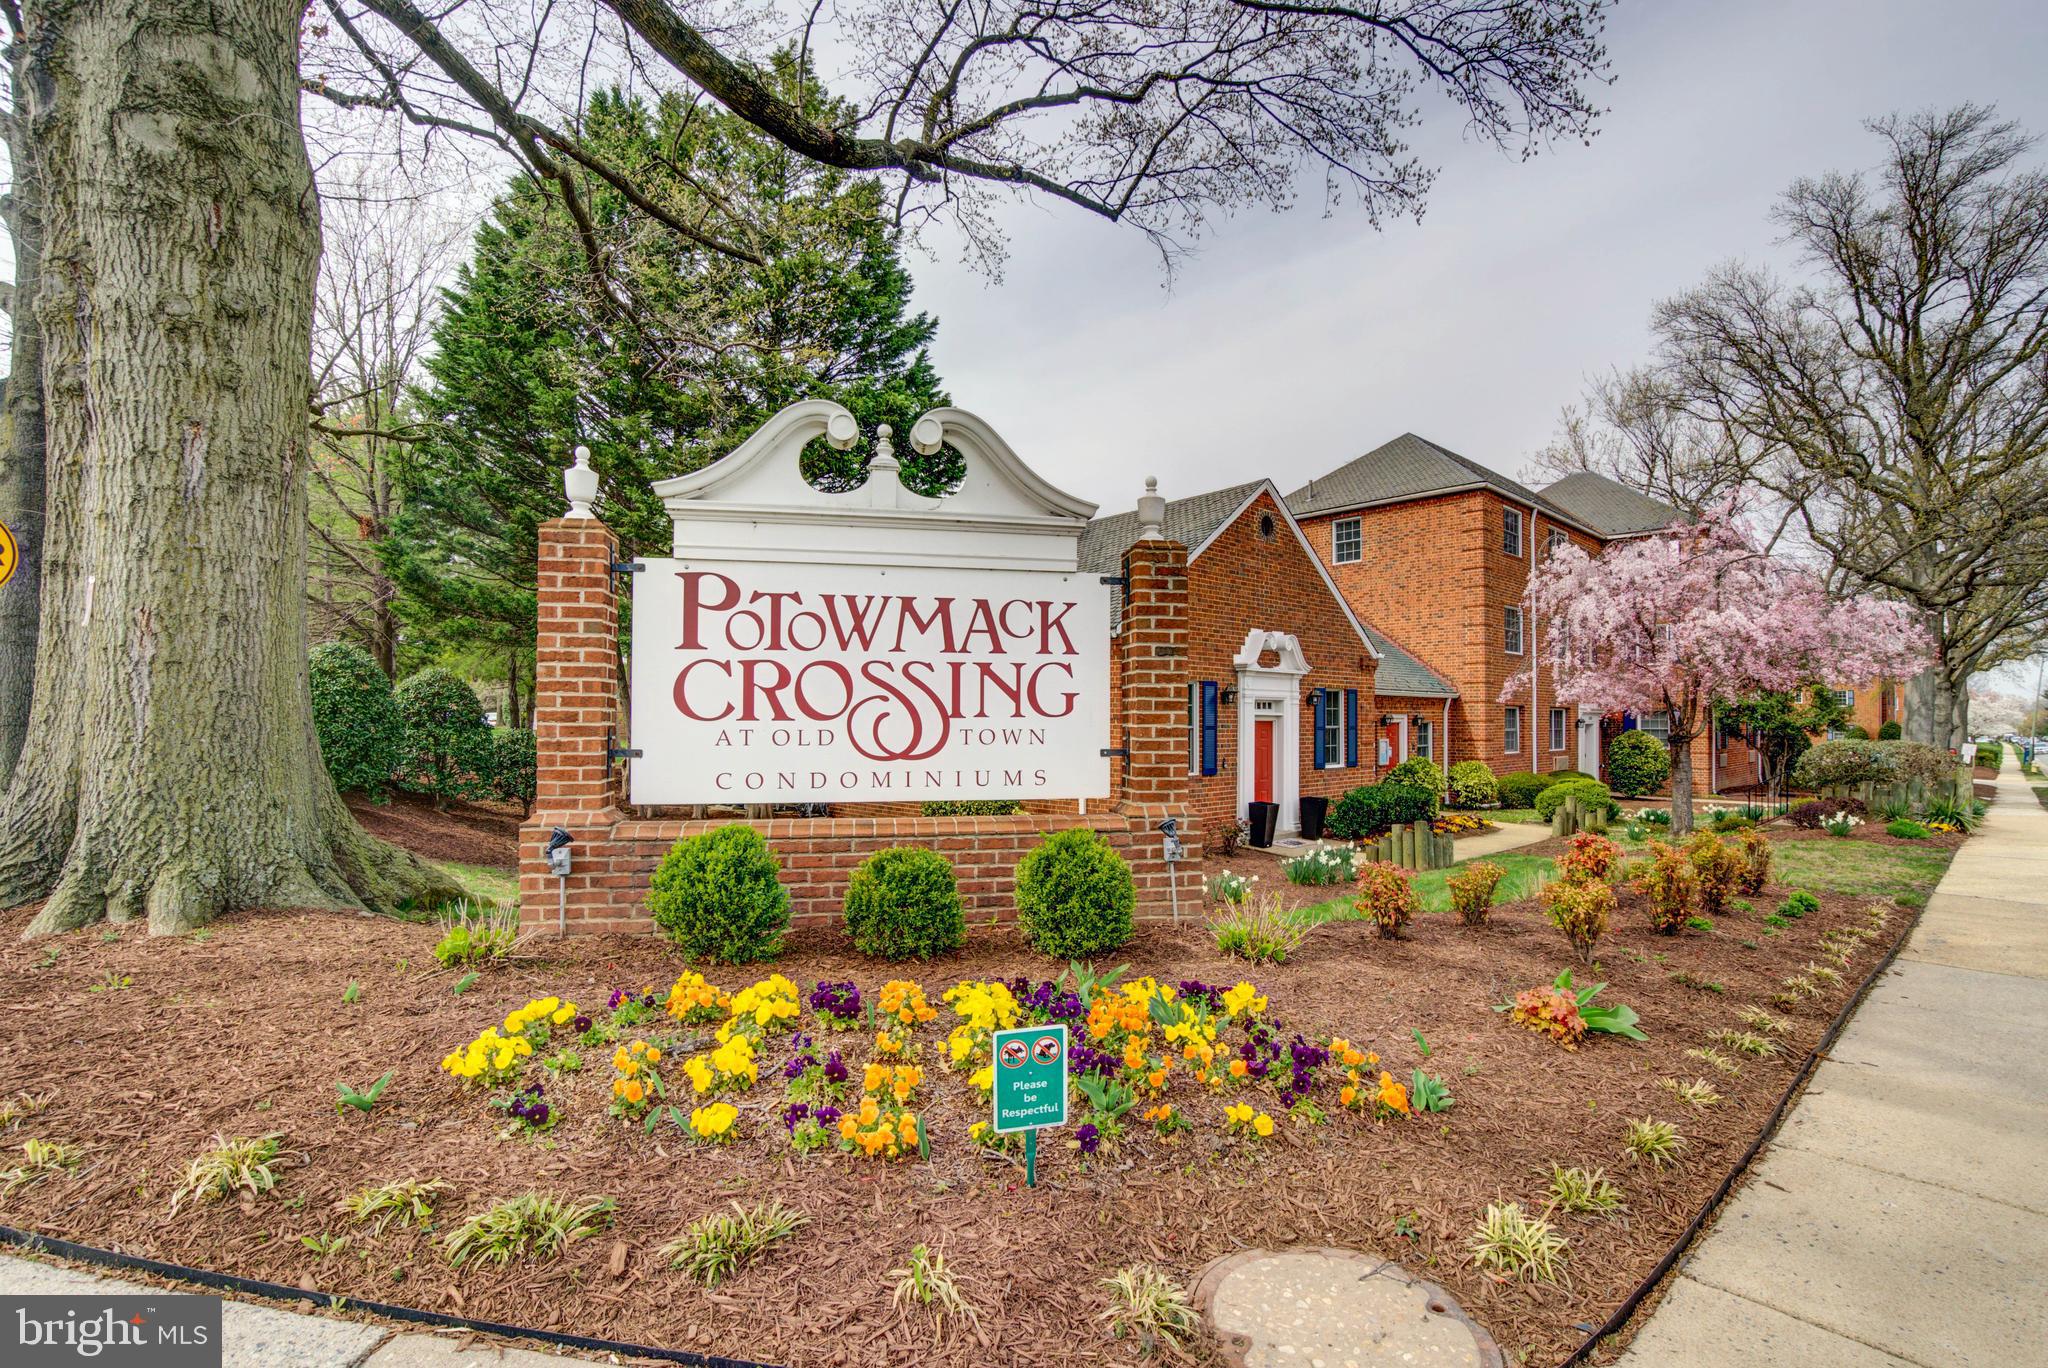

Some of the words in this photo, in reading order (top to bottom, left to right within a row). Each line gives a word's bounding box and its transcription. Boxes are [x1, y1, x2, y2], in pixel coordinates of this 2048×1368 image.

[672, 658, 1081, 762] CROSSING
[714, 729, 754, 747] AT
[771, 729, 835, 747] OLD
[959, 728, 1047, 746] TOWN
[714, 769, 1047, 791] CONDOMINIUMS
[1012, 1080, 1048, 1091] Please
[1023, 1093, 1038, 1103] be
[1001, 1102, 1059, 1118] Respectful
